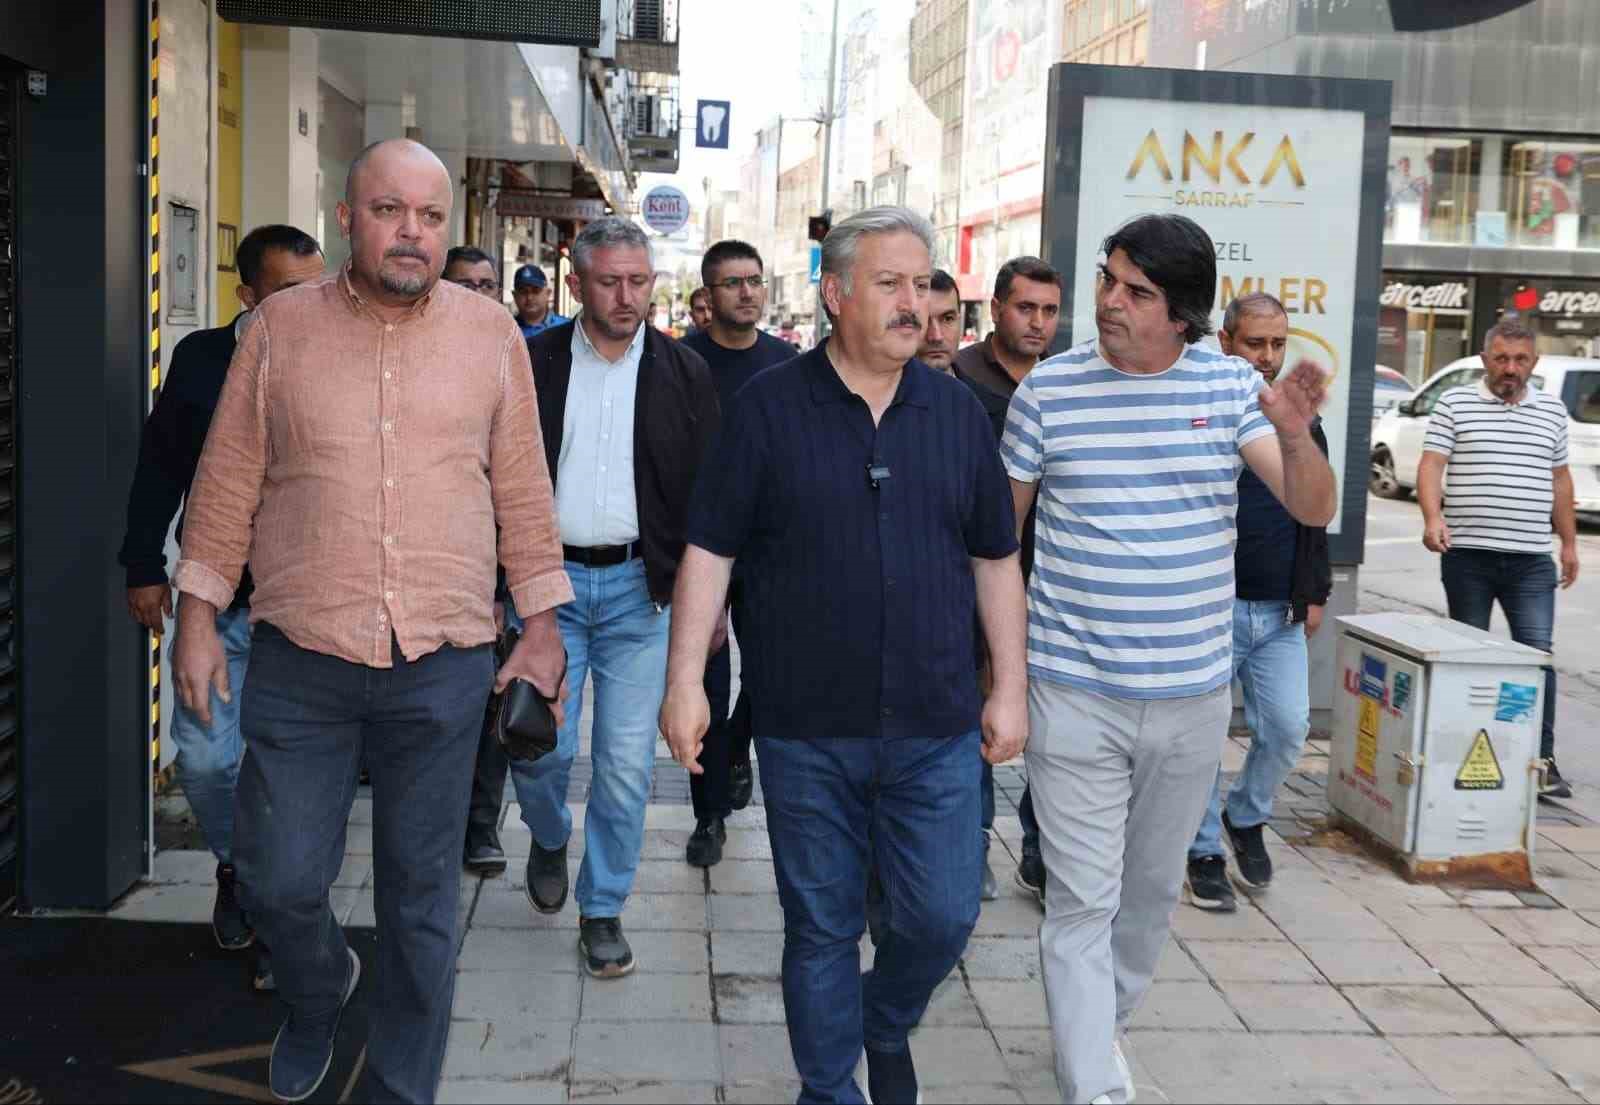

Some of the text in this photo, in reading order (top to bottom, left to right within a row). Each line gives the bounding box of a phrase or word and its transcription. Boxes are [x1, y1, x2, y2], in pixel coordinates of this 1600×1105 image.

[1125, 128, 1305, 187] ANKA
[648, 199, 681, 212] Kent
[1214, 241, 1253, 262] ZEL
